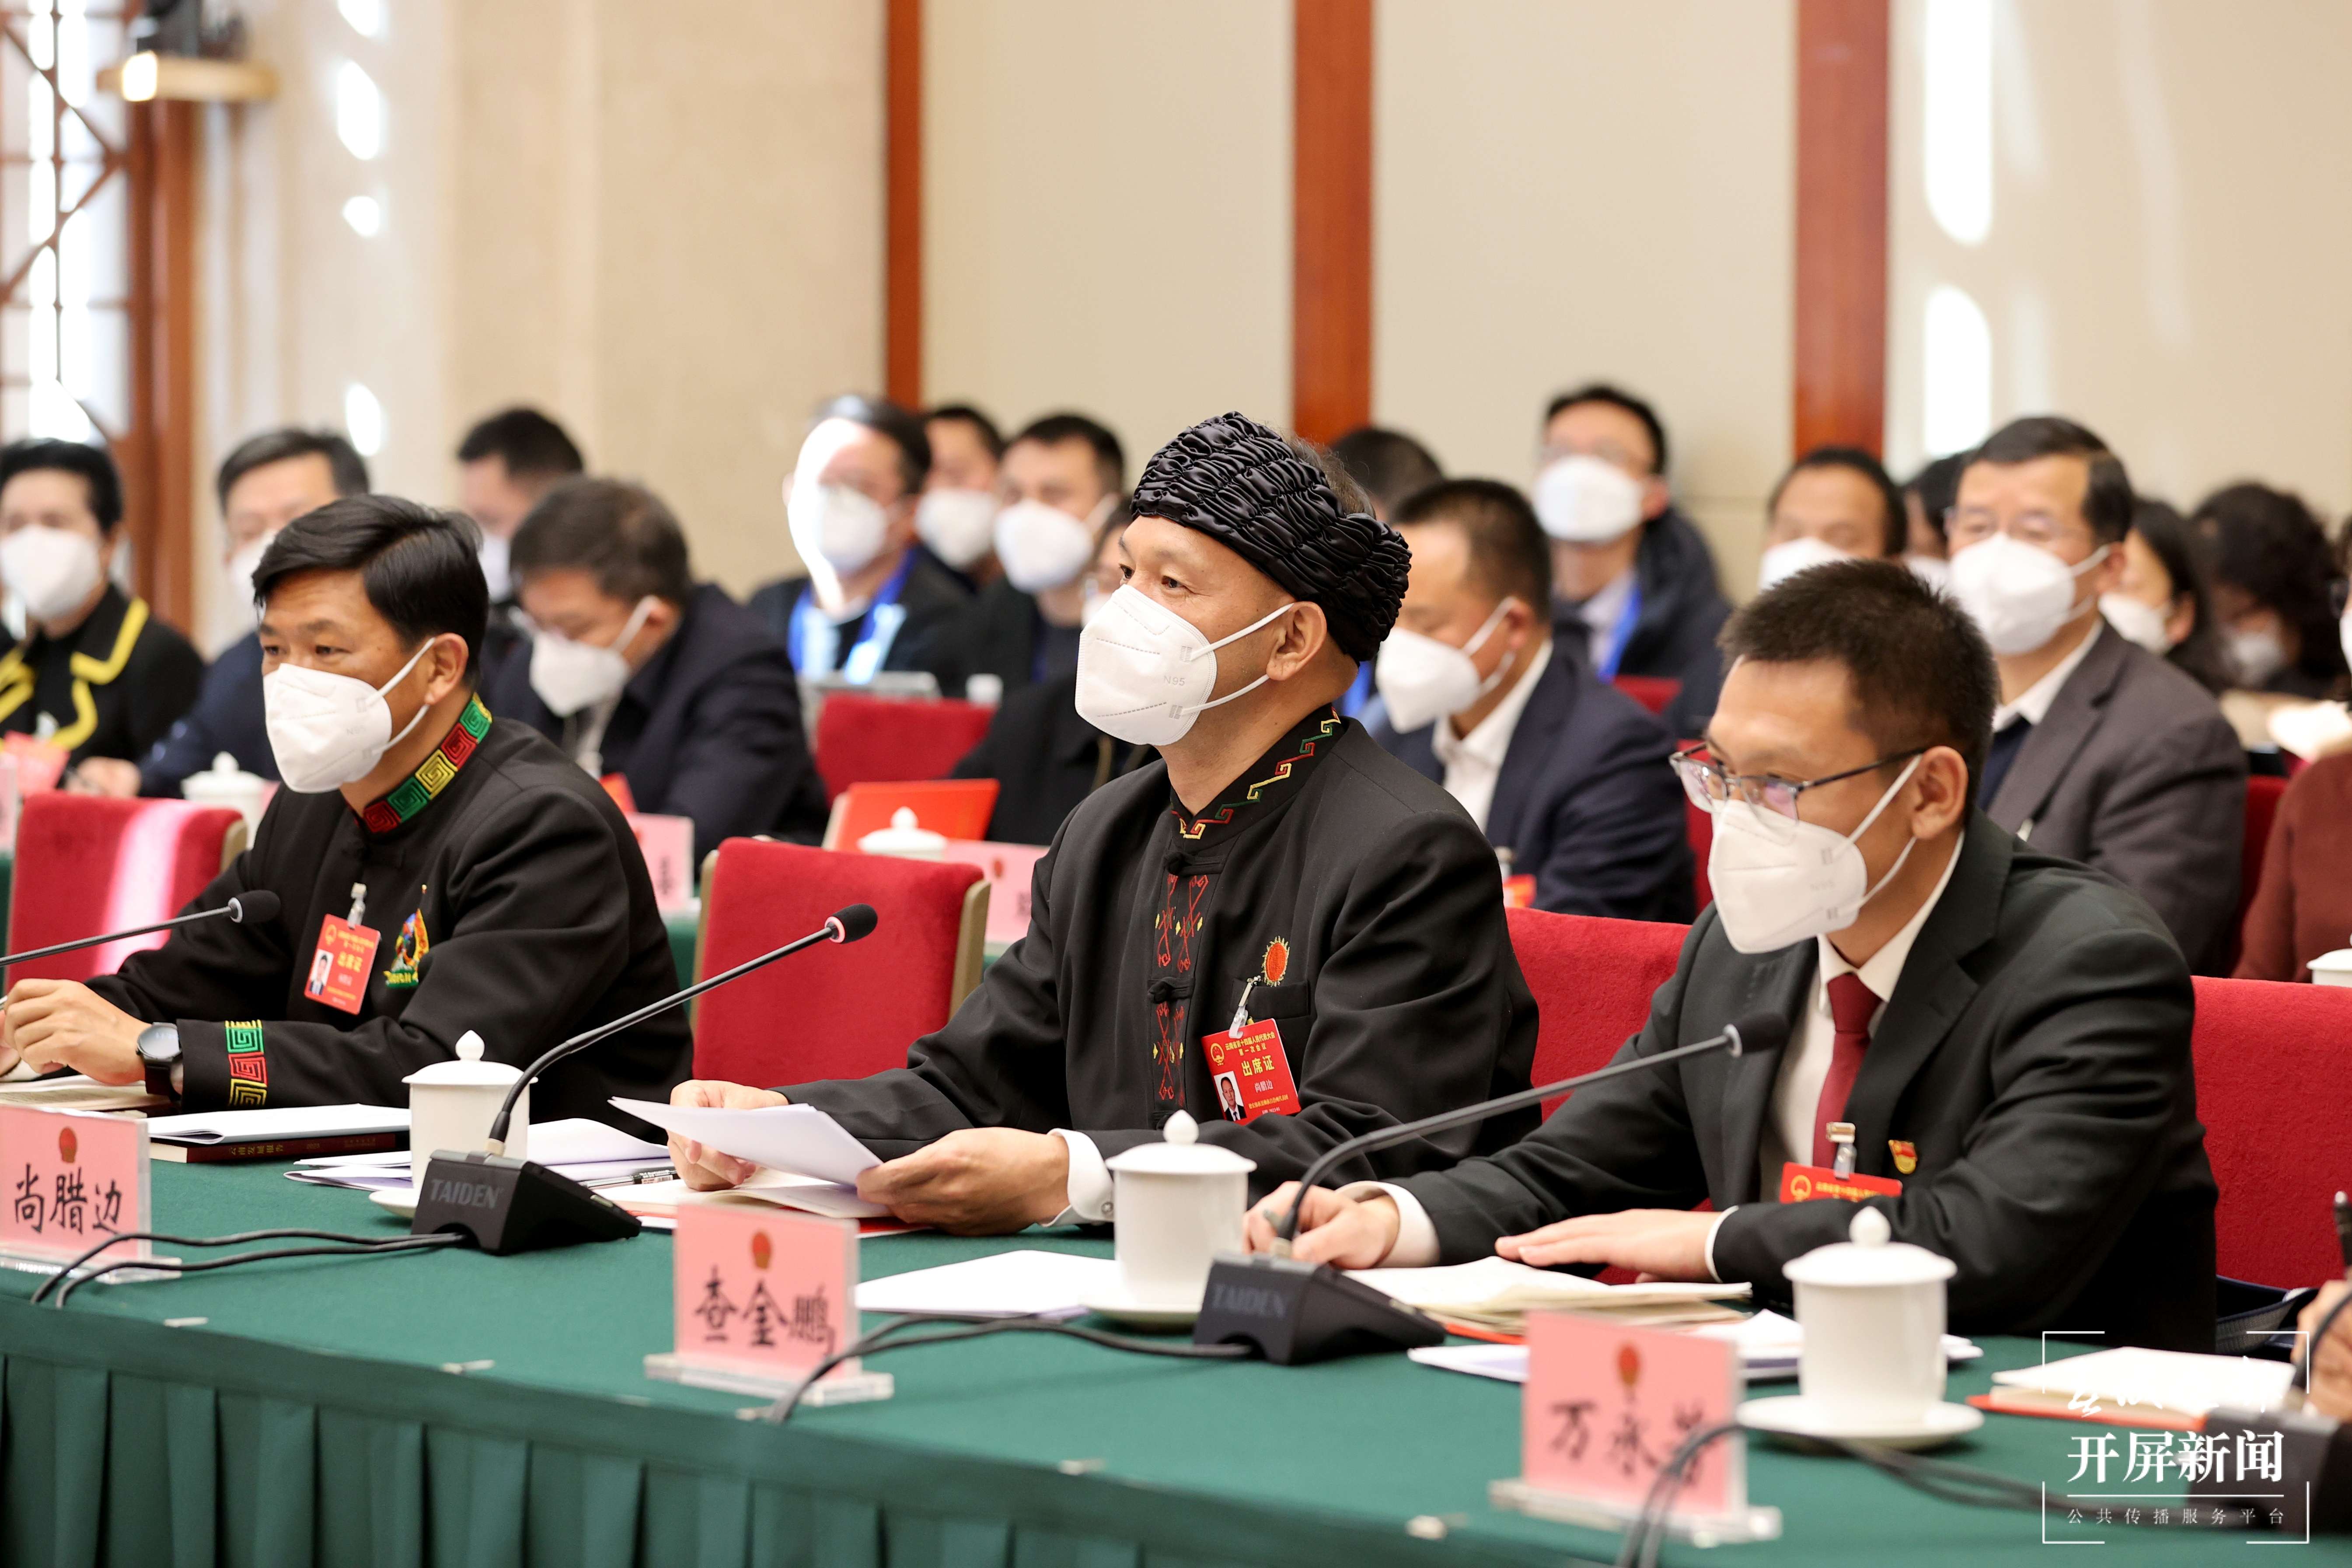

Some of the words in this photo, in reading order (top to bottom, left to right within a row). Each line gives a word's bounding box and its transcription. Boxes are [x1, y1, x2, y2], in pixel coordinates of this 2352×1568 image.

[1164, 675, 1186, 686] N95
[1225, 1031, 1276, 1051] 云南省第十四届人民代表大会
[1239, 1042, 1267, 1056] 第一次会议
[1241, 1055, 1275, 1077] 出席证
[14, 1163, 122, 1235] 尚腊边
[429, 1179, 500, 1209] TAIDEN
[695, 1265, 837, 1356] 查金鹏
